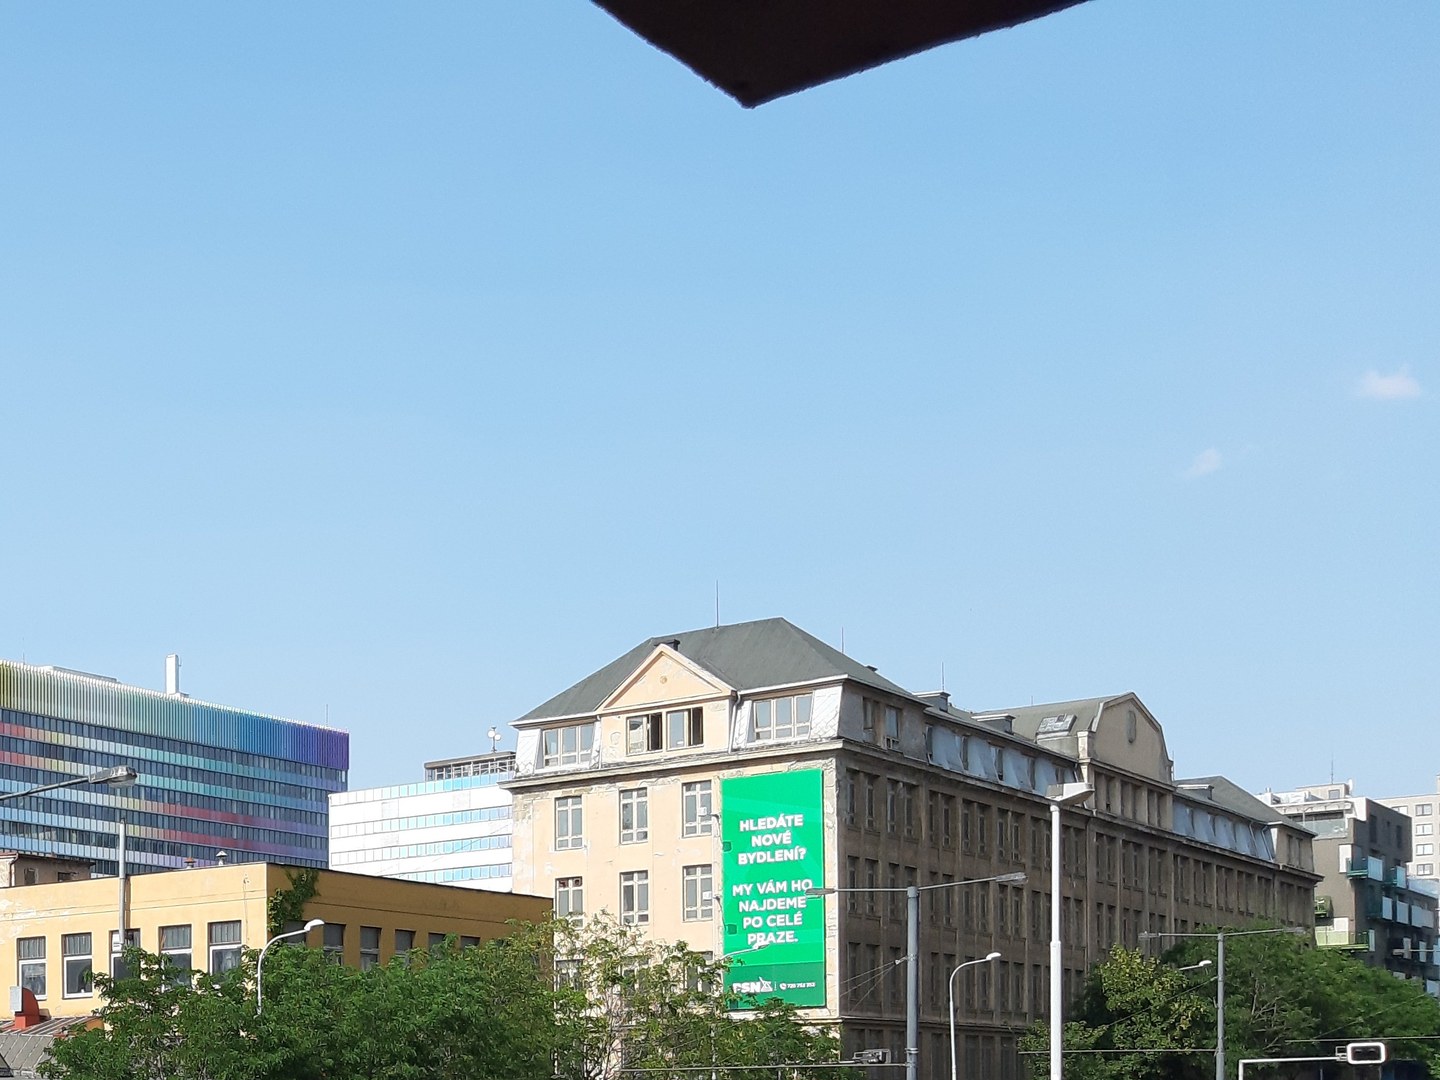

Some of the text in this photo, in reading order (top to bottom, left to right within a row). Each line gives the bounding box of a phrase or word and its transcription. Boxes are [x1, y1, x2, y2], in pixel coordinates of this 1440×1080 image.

[739, 813, 804, 832] HLEDÁTE
[751, 830, 792, 847] NOVÉ
[738, 846, 807, 866] BYDLENÍ?
[732, 879, 813, 897] MY VÁM HO
[738, 895, 807, 912] NAJDEME
[743, 911, 803, 929] PO CELÉ
[747, 930, 799, 946] PRAZE.
